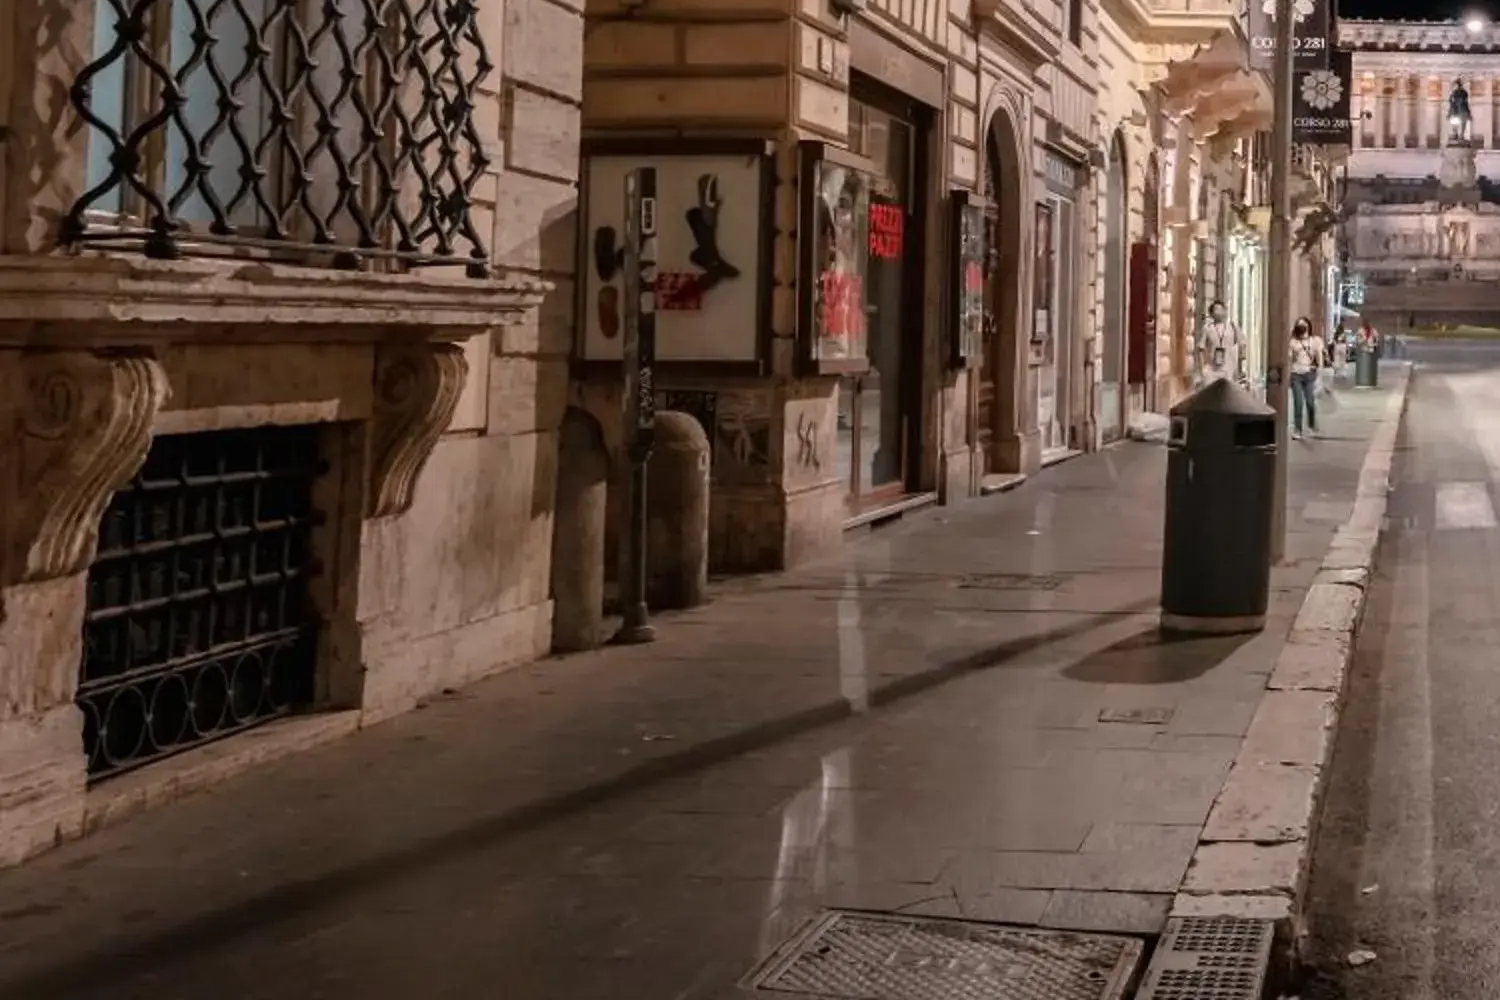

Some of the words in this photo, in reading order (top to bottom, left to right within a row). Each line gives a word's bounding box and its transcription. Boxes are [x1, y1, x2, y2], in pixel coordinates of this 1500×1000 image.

[1303, 37, 1325, 49] 281
[1294, 118, 1331, 128] CORSO
[1333, 119, 1349, 129] 281
